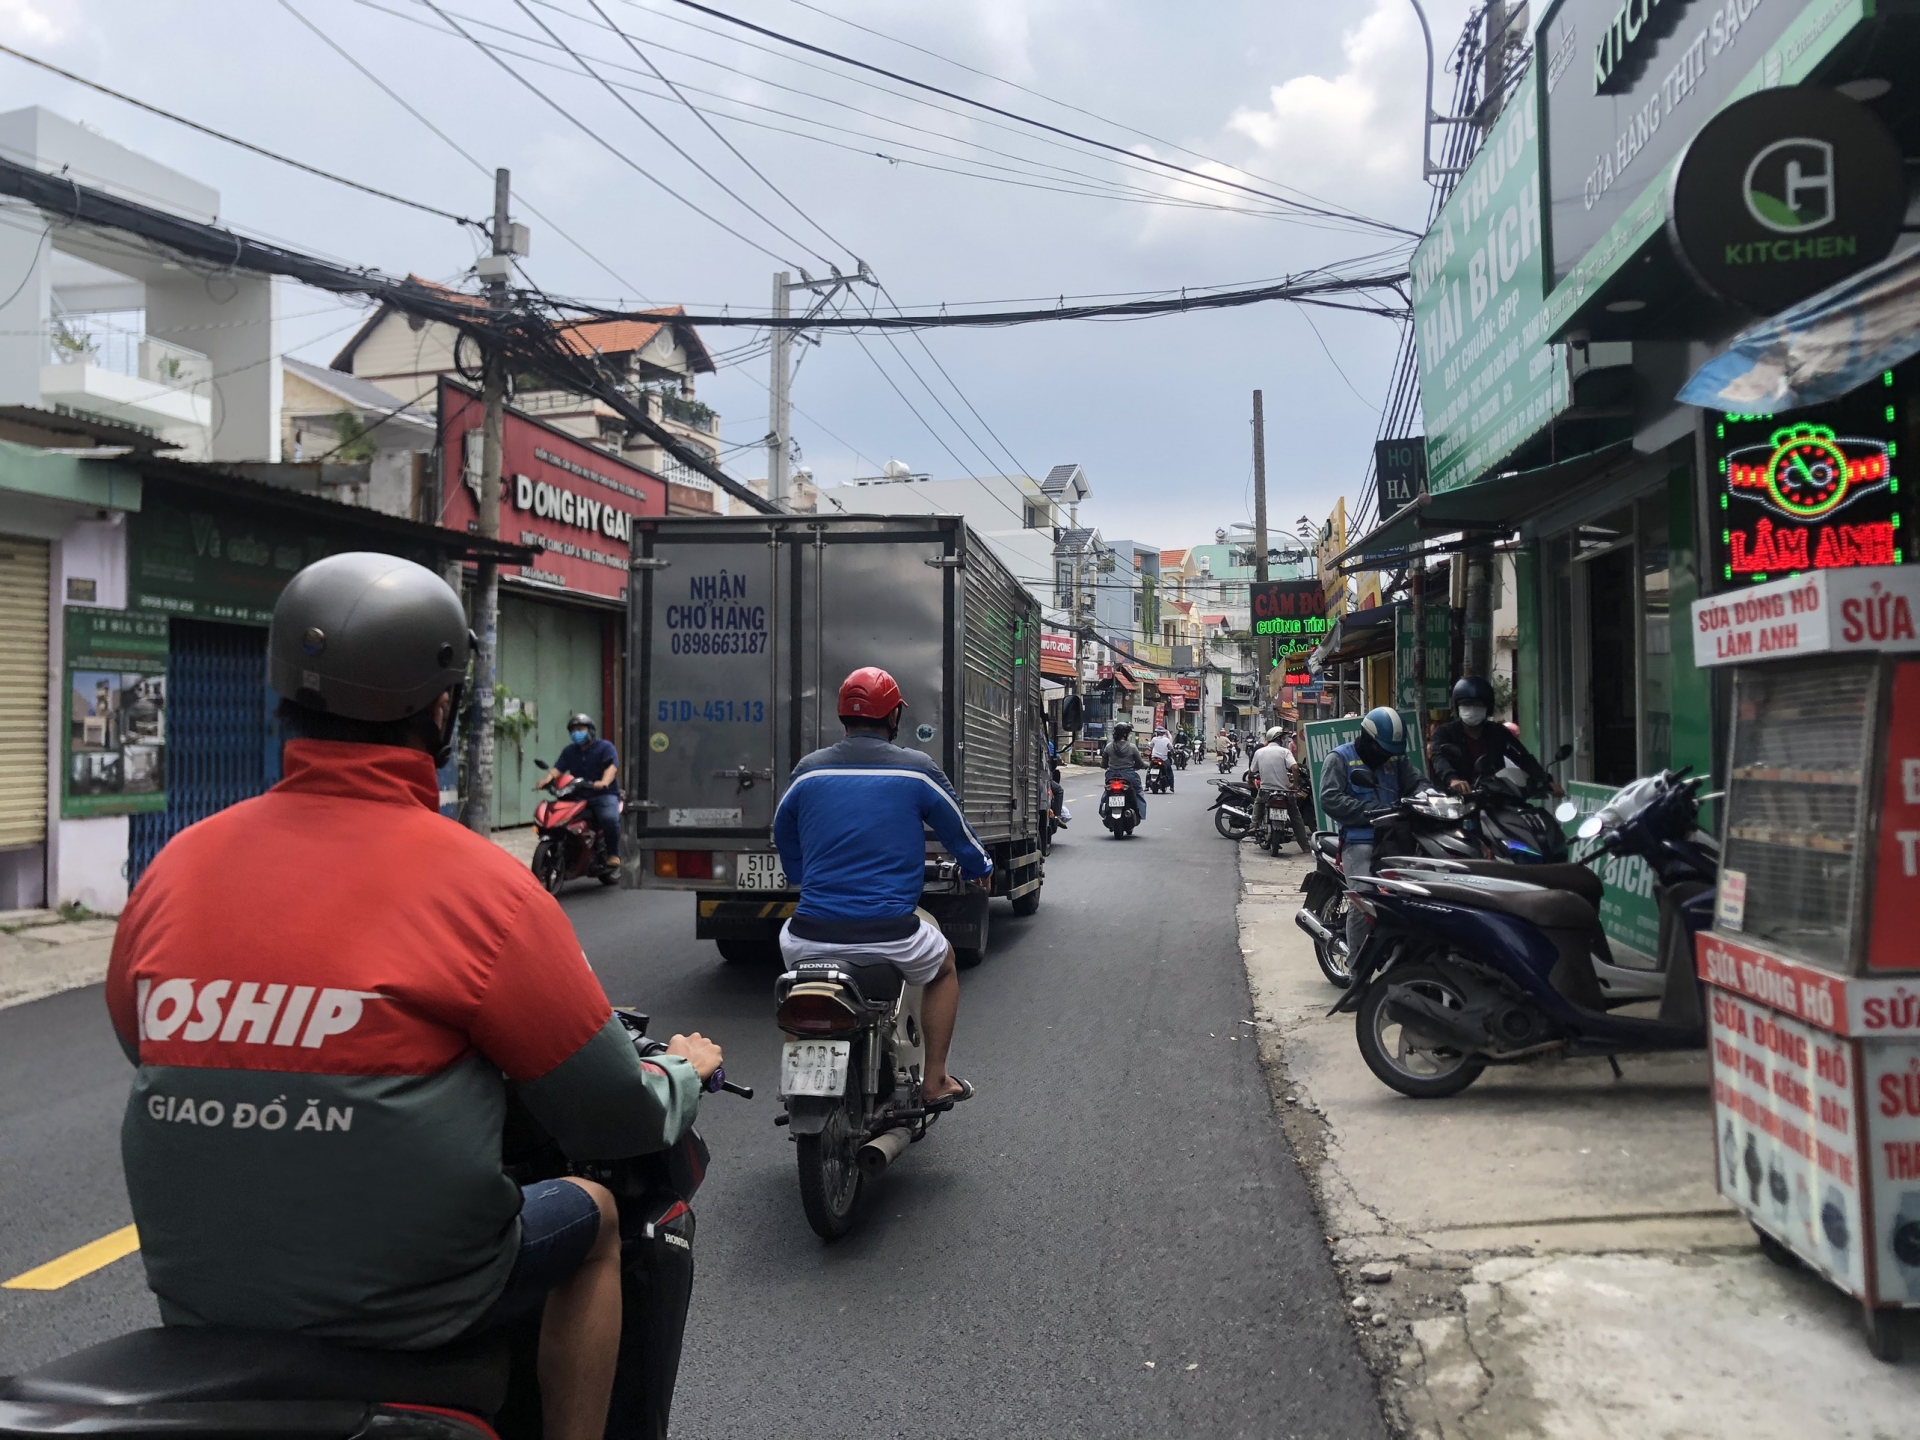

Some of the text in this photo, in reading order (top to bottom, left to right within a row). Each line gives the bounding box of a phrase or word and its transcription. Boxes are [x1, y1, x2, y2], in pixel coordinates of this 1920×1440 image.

[1415, 214, 1456, 302] NHÀ
[1724, 236, 1857, 265] KITCHEN
[1423, 274, 1463, 376] HẢI
[1469, 172, 1540, 321] BÍCH
[1498, 288, 1520, 332] GPP
[1730, 517, 1896, 572] LÂM ANH
[689, 569, 746, 603] NHẬN
[1698, 576, 1820, 633] SỬA ĐỒNG HỒ
[711, 601, 765, 630] HÀNG
[1257, 617, 1301, 634] CƯỜNG
[1841, 580, 1915, 643] SỬA
[671, 632, 767, 655] 0898663187
[1057, 642, 1071, 653] ZONE
[1717, 623, 1798, 659] LÂM ANH
[738, 872, 786, 889] 451.13
[748, 855, 775, 872] 51D
[1706, 942, 1835, 1027] SỬA ĐỒNG HỒ
[138, 978, 392, 1049] OSHIP
[1863, 985, 1920, 1030] SỬ
[1713, 993, 1847, 1089] SỬA ĐỒNG HỒ
[148, 1094, 354, 1132] GIAO ĐỒ ĂN
[664, 1233, 690, 1250] HONDA
